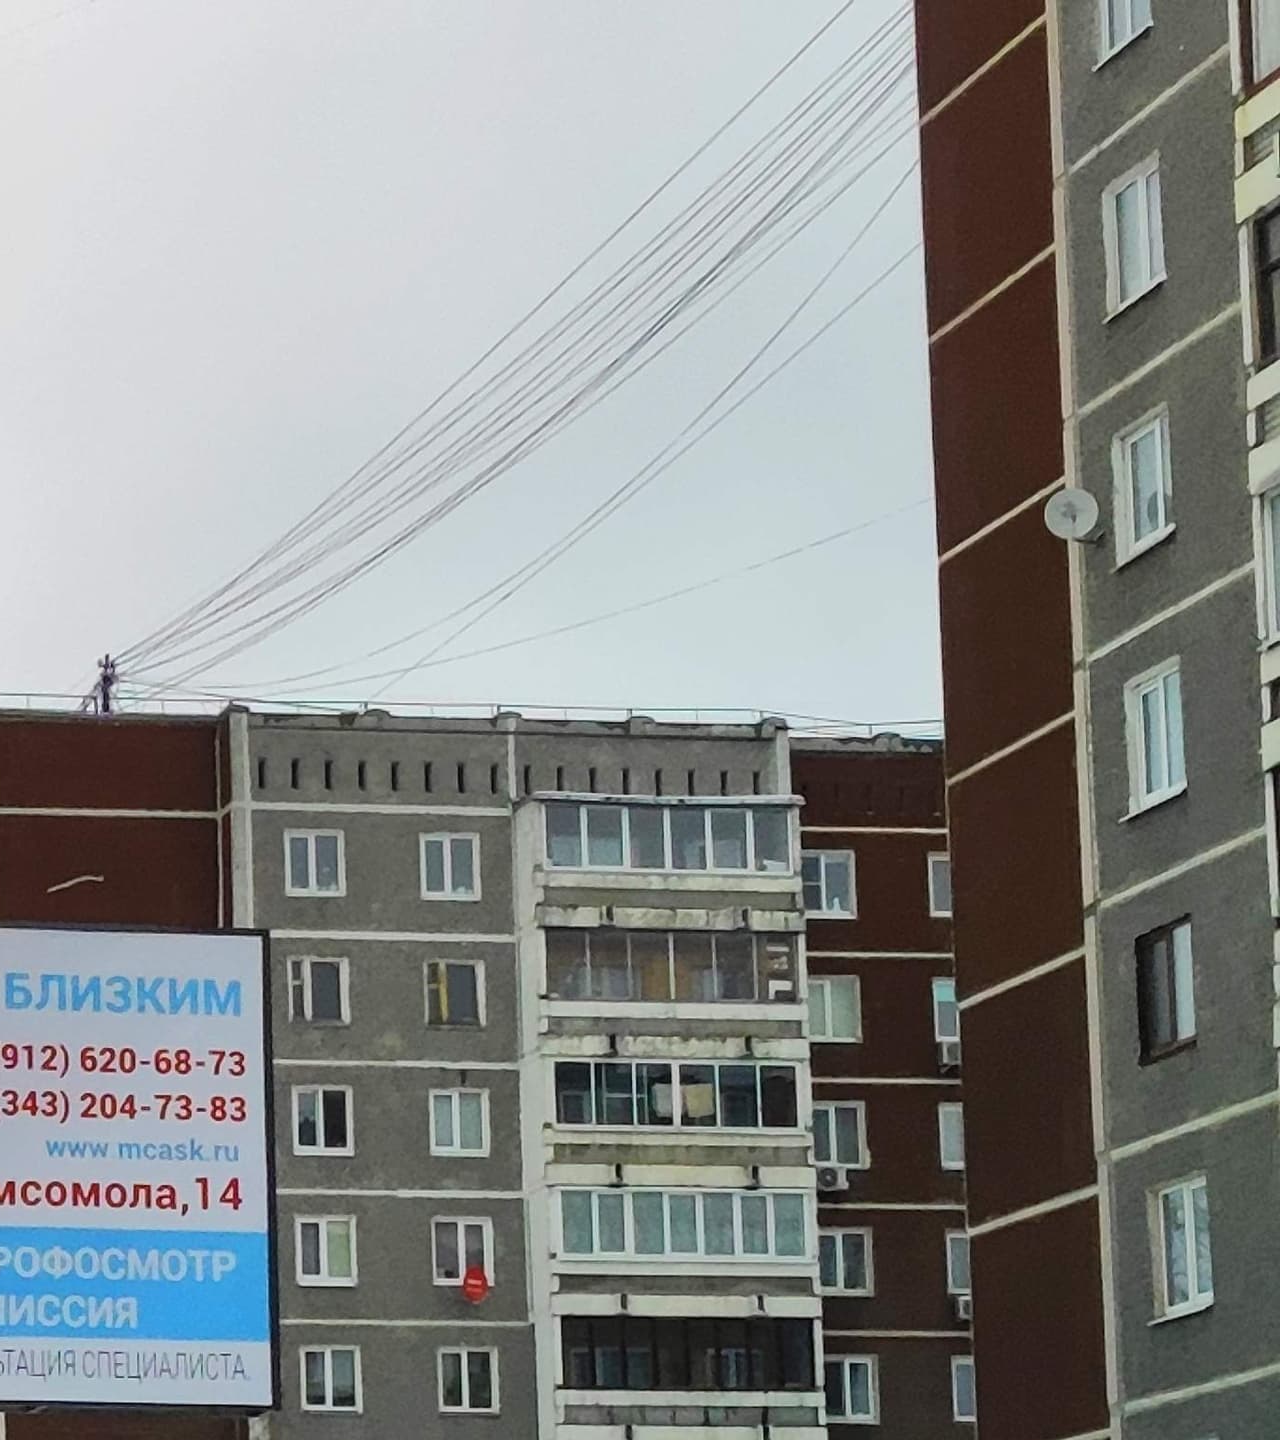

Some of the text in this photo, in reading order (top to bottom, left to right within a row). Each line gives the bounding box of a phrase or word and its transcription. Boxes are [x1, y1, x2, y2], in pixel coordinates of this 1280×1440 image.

[5, 973, 242, 1017] БЛИЗКИМ
[79, 1047, 247, 1077] 620-68-73
[79, 1093, 247, 1122] 204-73-83
